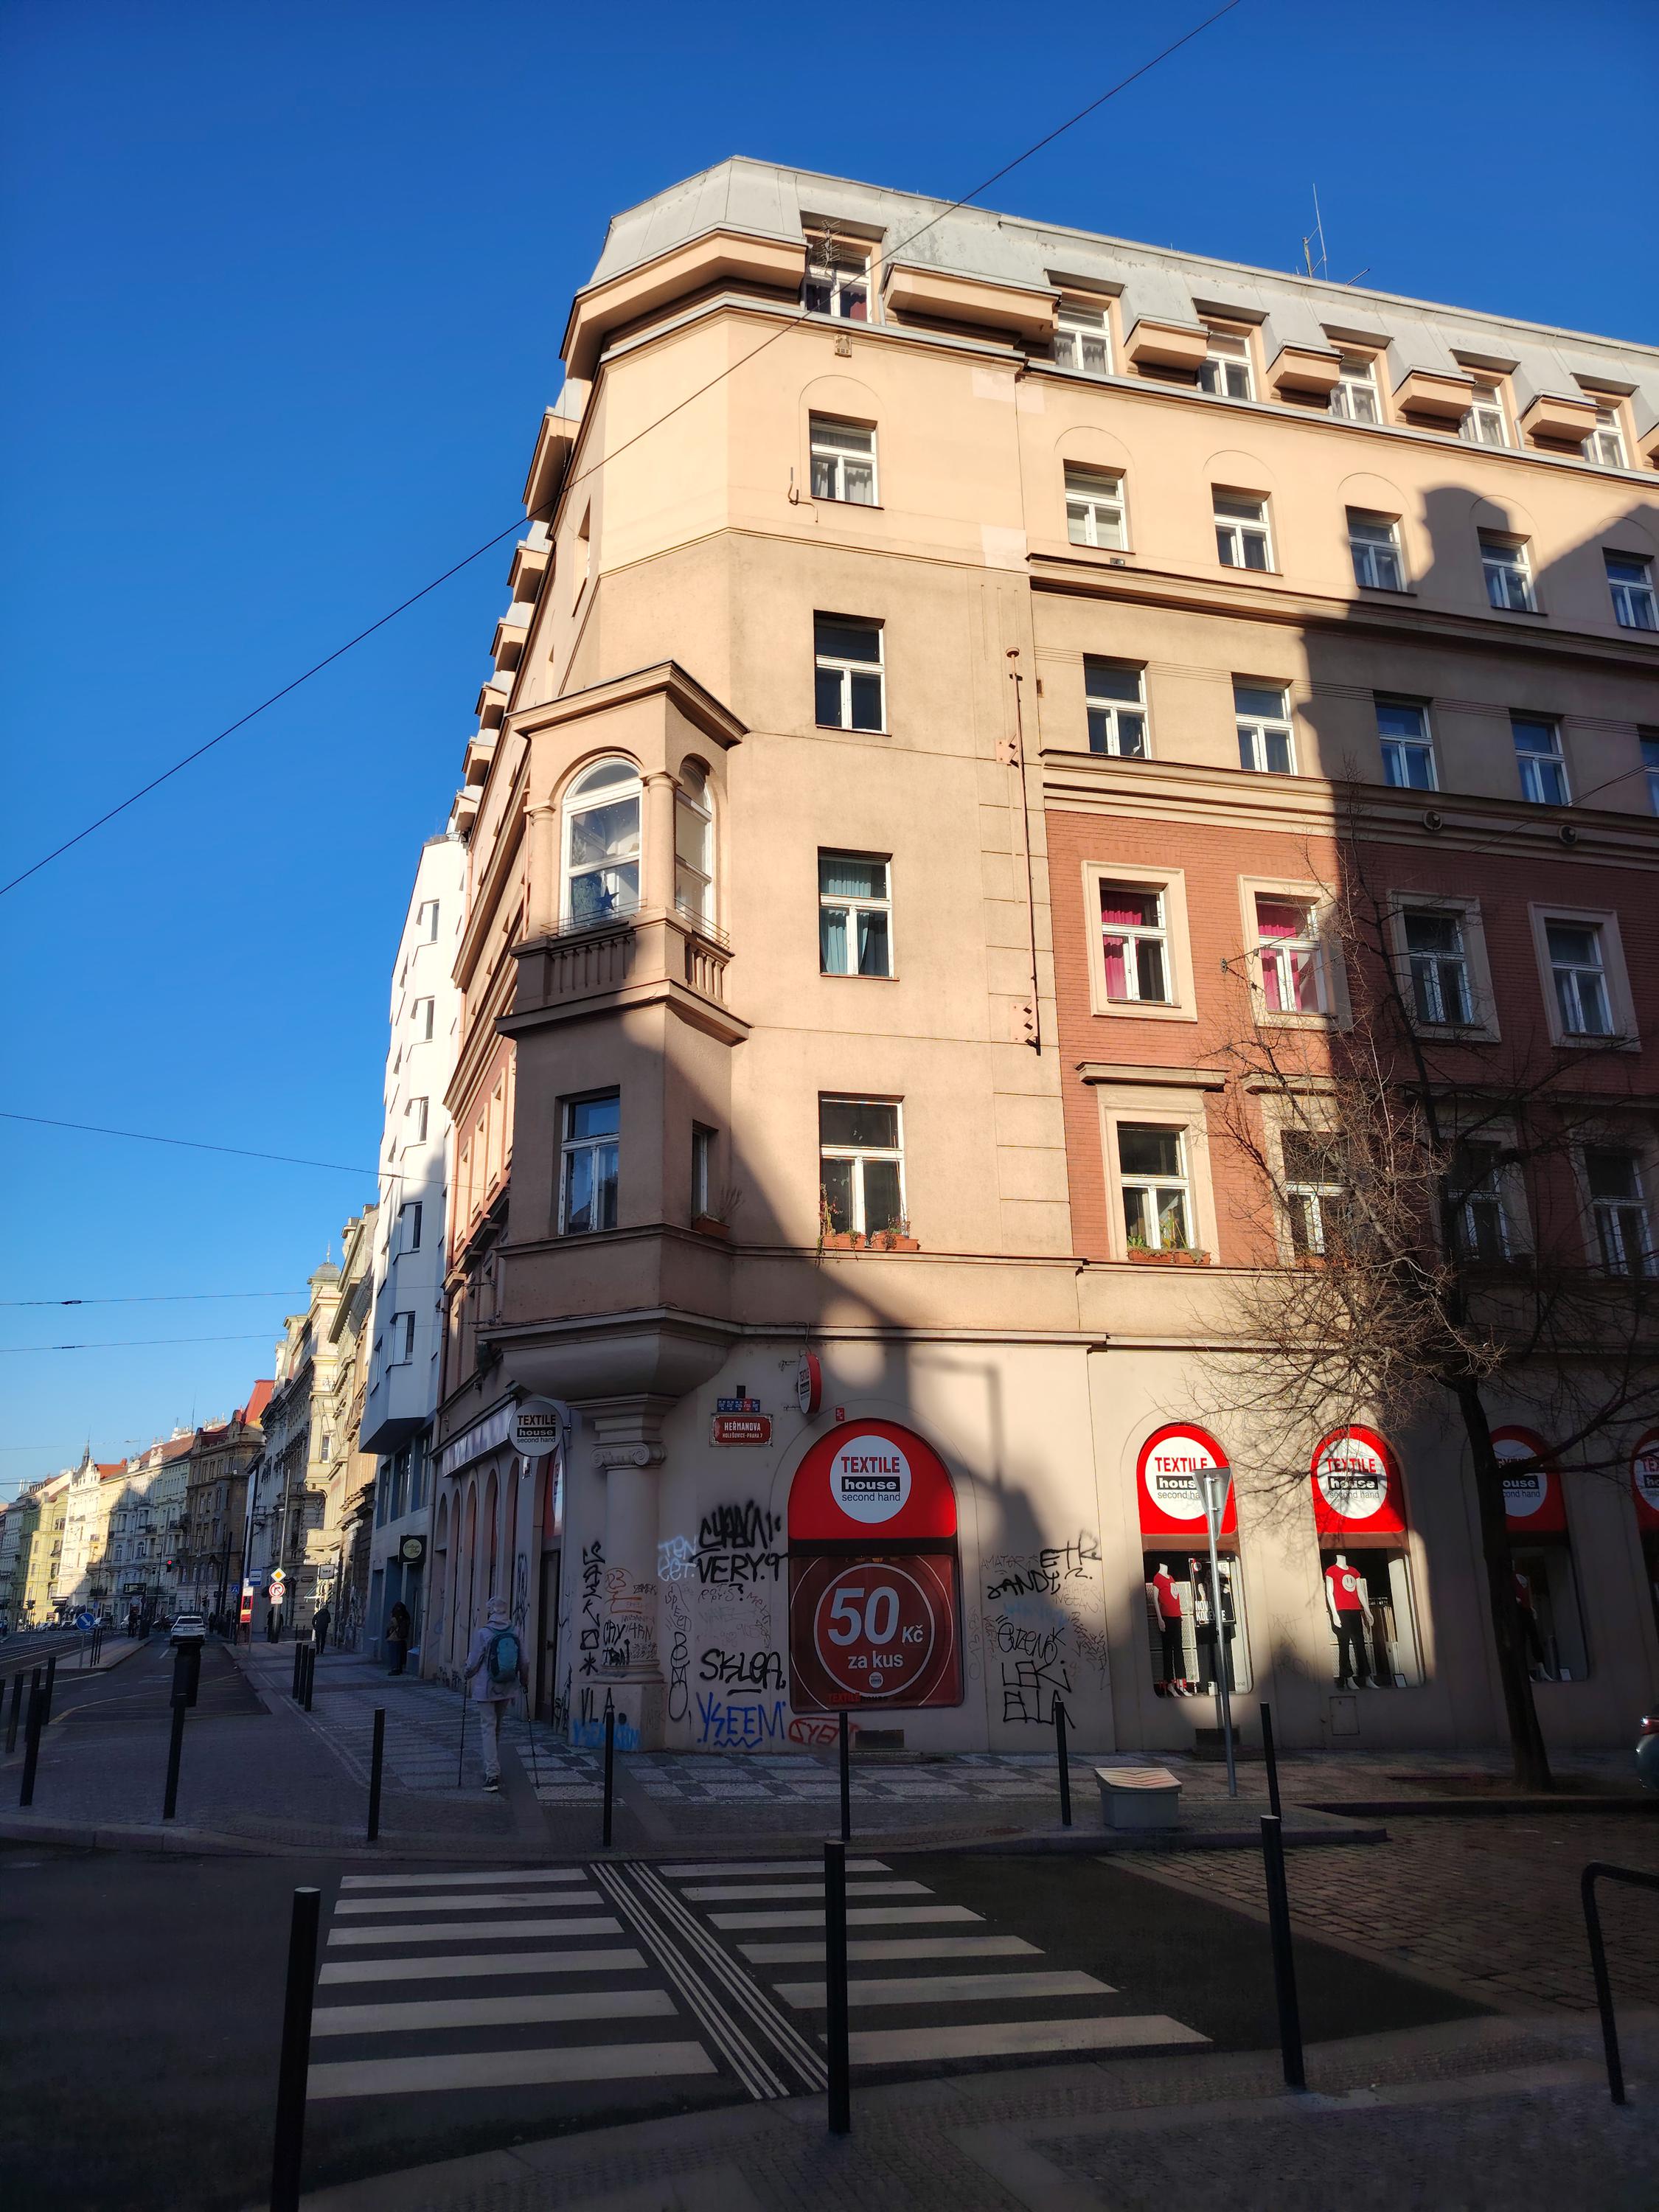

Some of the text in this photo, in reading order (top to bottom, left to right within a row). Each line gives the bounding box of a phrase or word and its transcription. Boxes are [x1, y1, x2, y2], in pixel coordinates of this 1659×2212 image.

[518, 1415, 556, 1425] TEXTILE
[724, 1421, 761, 1431] HEŘMANOVA
[841, 1456, 900, 1473] TEXTILE
[1326, 1458, 1377, 1473] TEXTILE
[844, 1478, 897, 1490] house
[1159, 1477, 1197, 1489] hous
[1330, 1478, 1376, 1489] house
[1502, 1479, 1537, 1488] ouse
[841, 1492, 901, 1501] second hand
[1157, 1491, 1200, 1499] second ha
[1329, 1490, 1380, 1499] second hand
[1522, 1489, 1540, 1498] hand
[827, 1586, 900, 1646] 50
[902, 1624, 924, 1644] Kč
[848, 1650, 903, 1669] za kus
